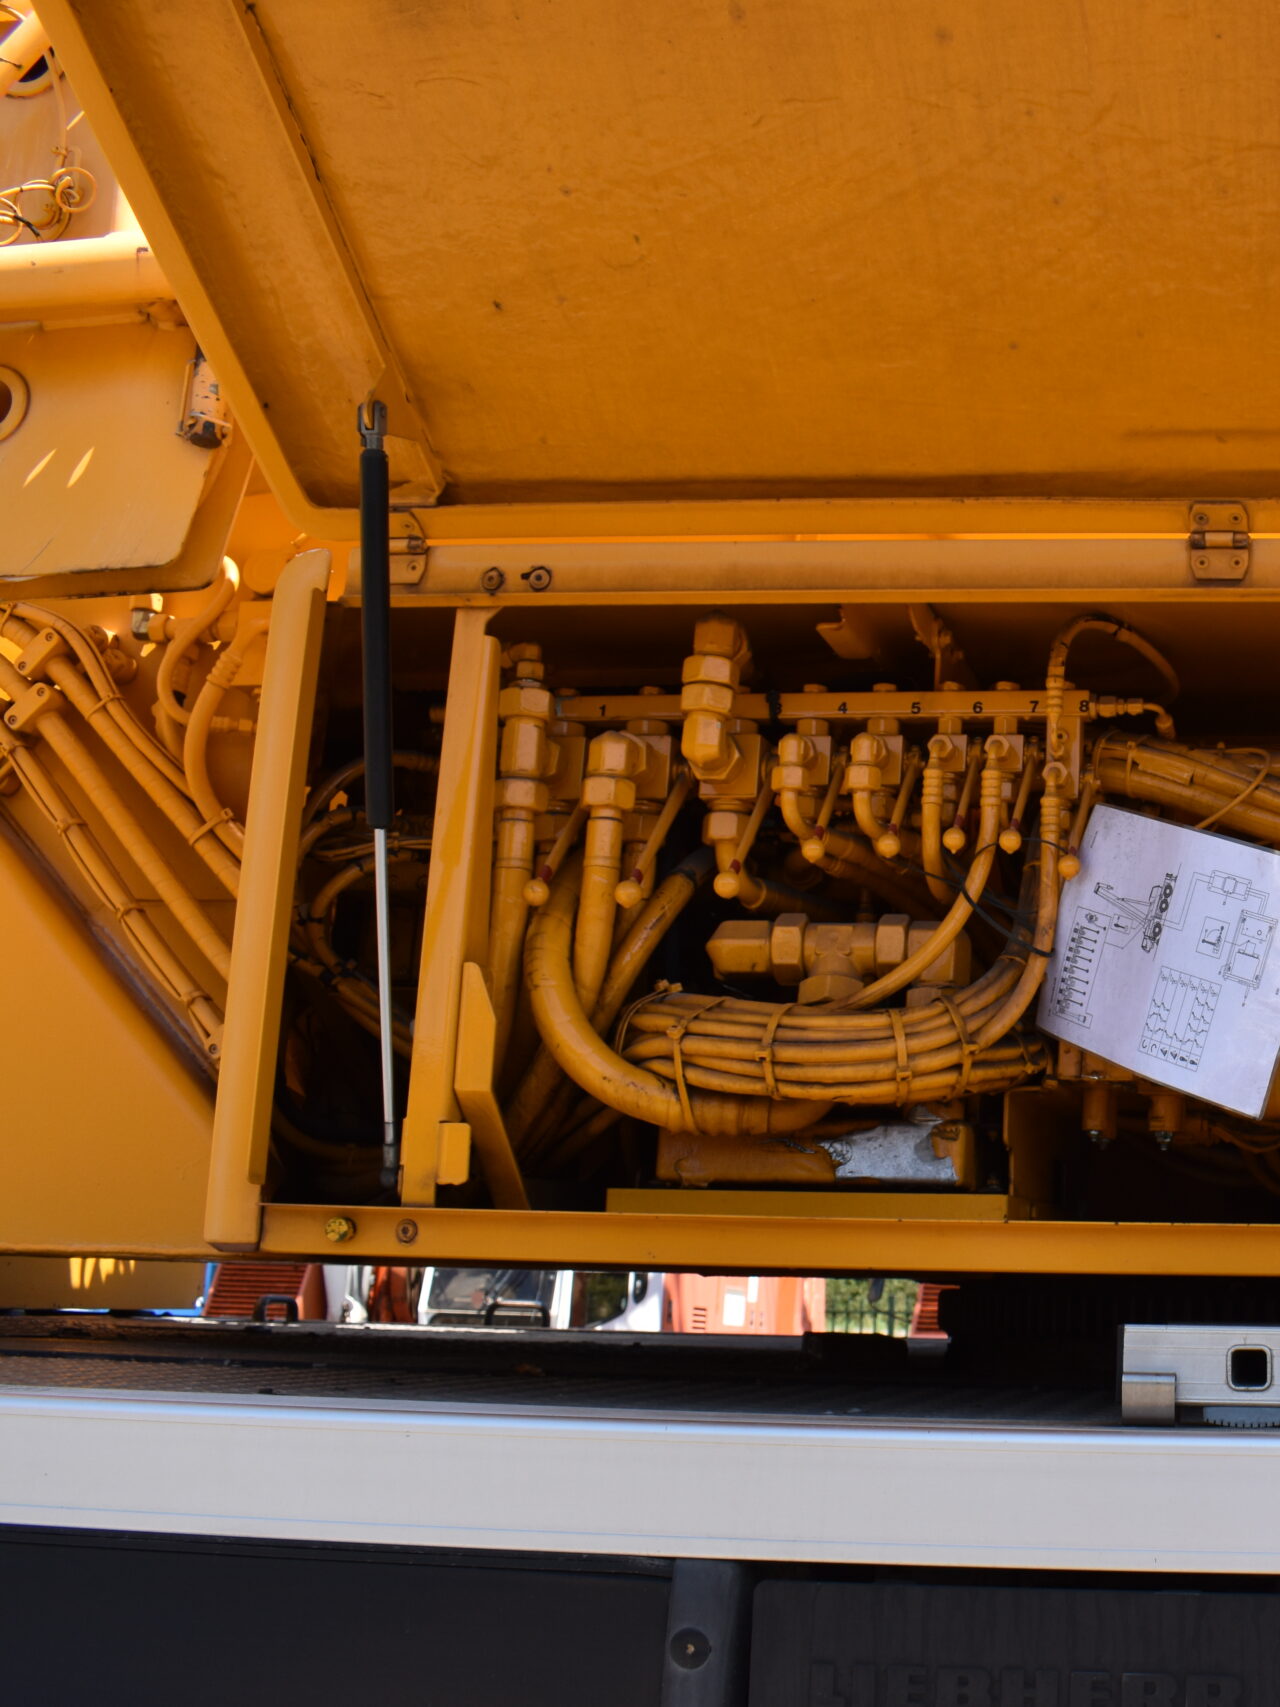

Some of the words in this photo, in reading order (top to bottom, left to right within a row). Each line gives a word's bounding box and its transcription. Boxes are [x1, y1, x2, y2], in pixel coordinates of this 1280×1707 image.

[599, 704, 607, 717] 1
[837, 702, 848, 714] 4
[911, 702, 921, 714] 5
[972, 701, 983, 714] 6
[1029, 700, 1039, 713] 7
[1078, 700, 1089, 713] 8
